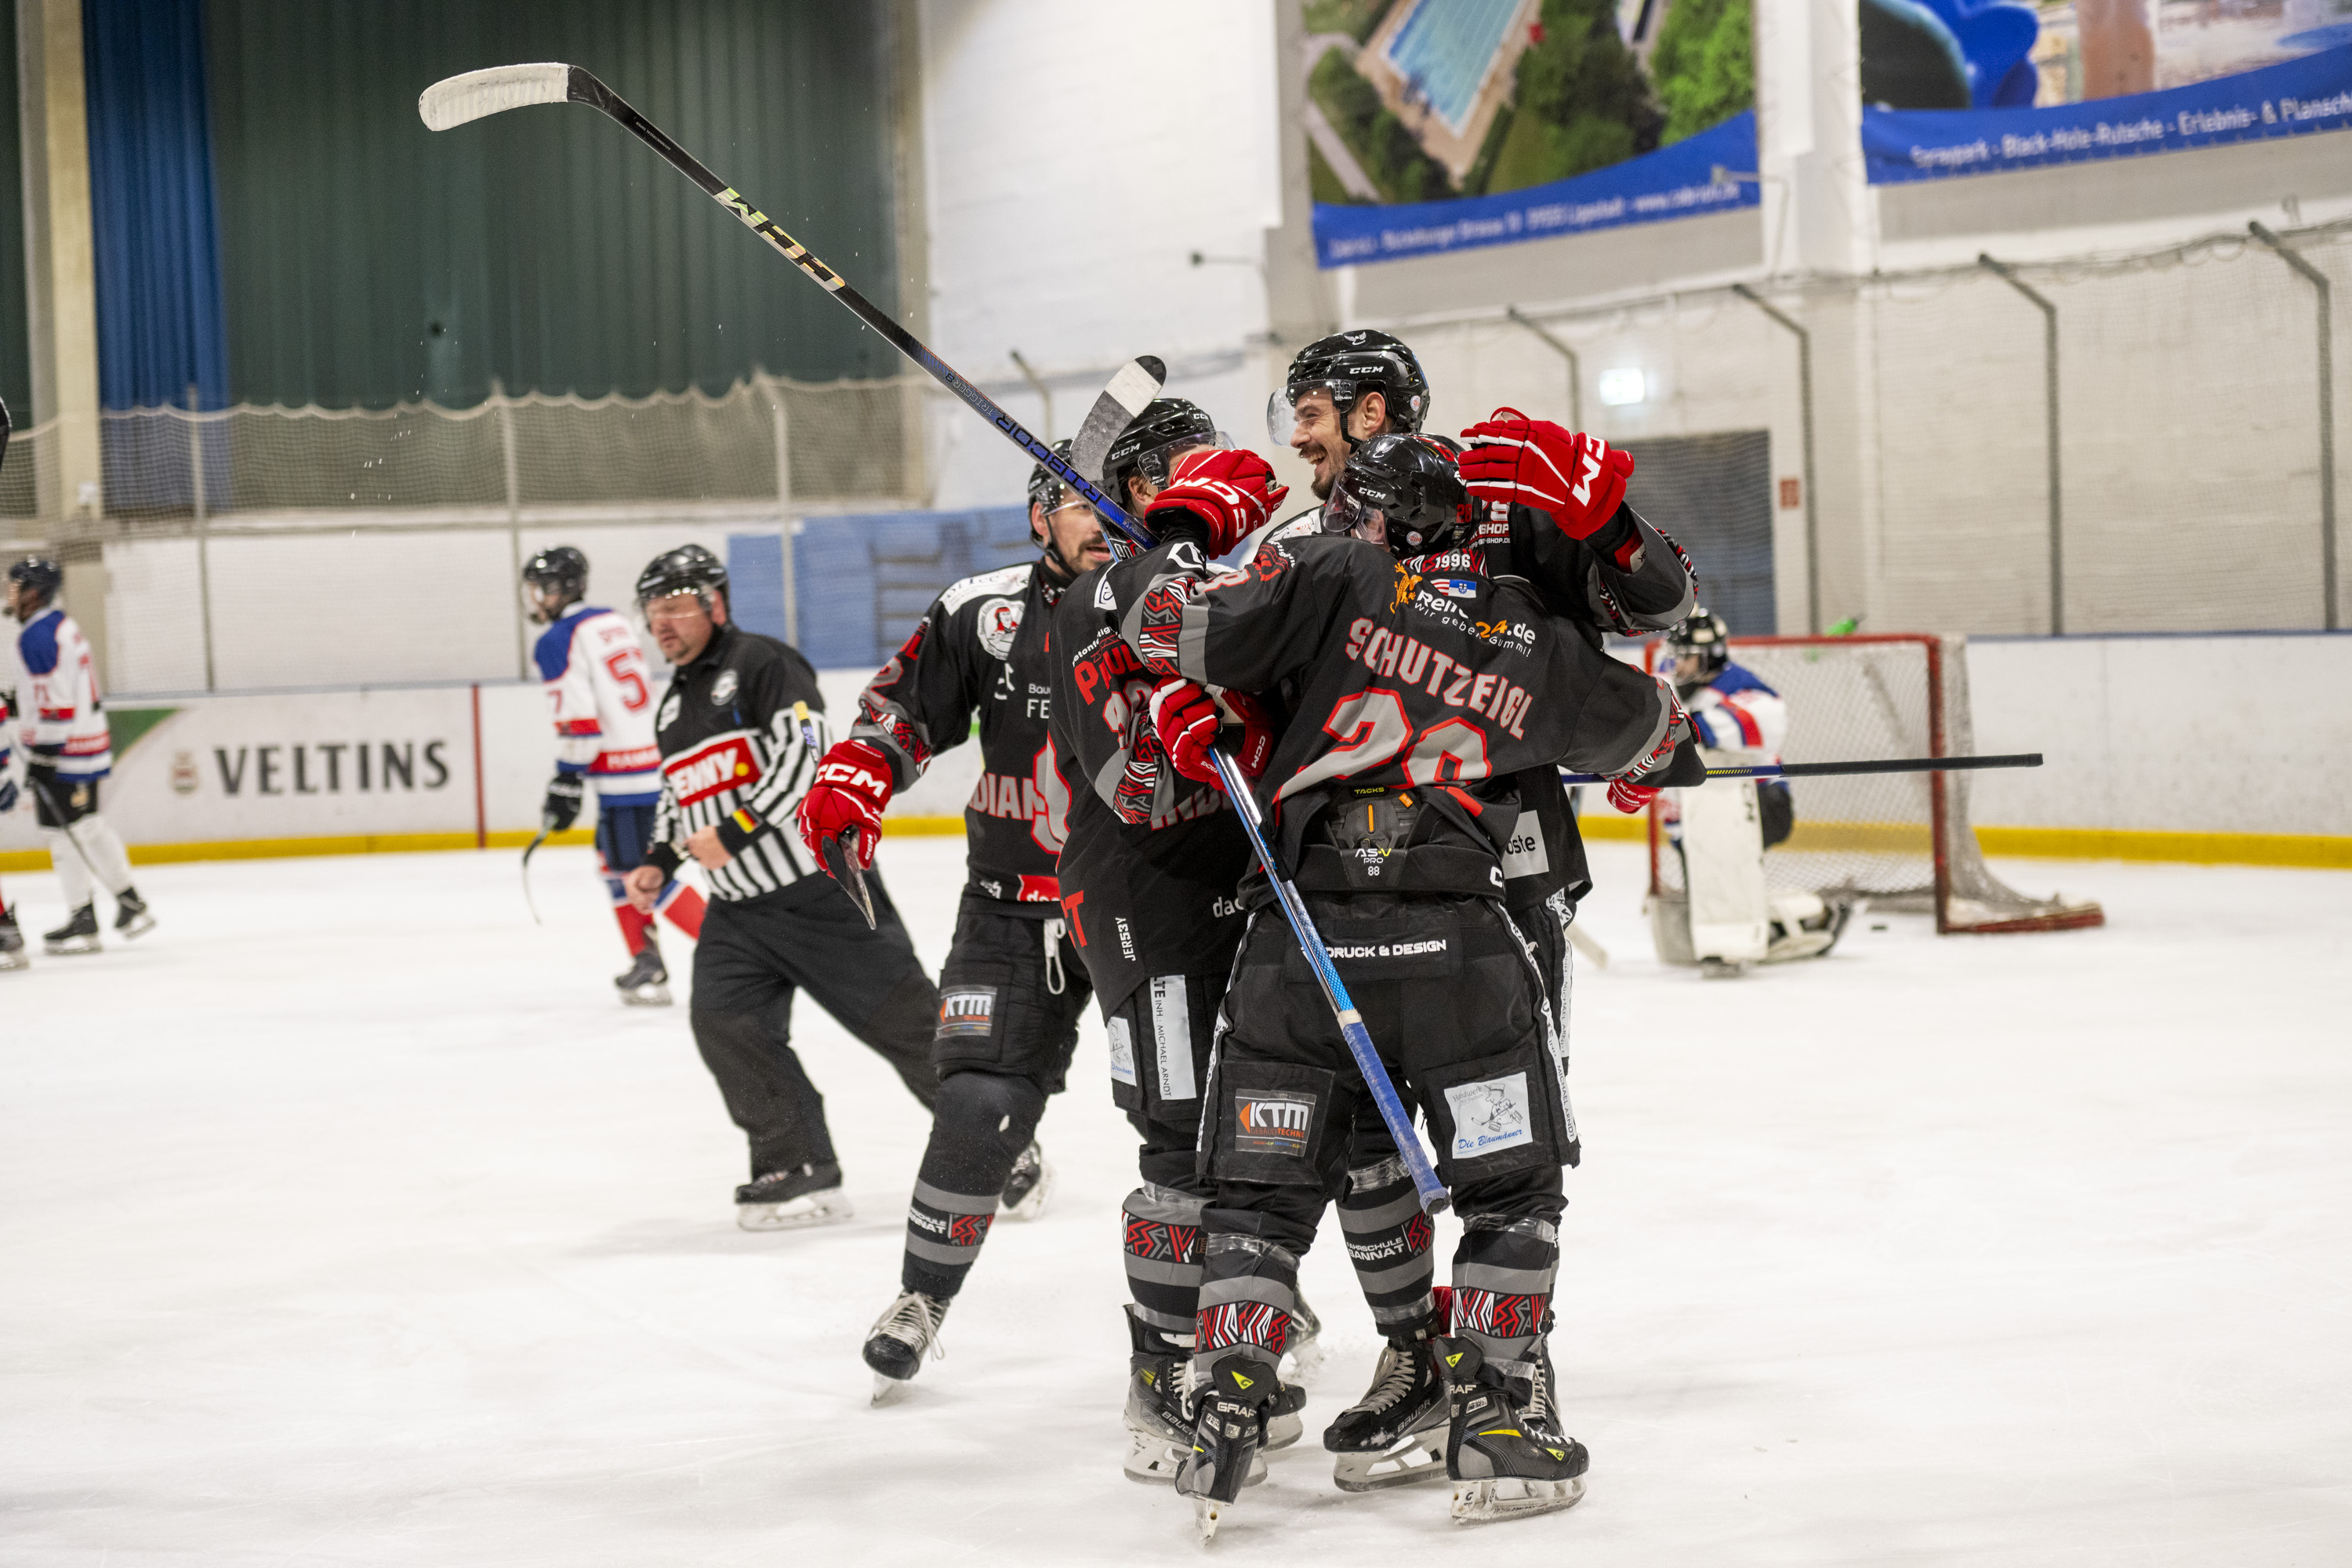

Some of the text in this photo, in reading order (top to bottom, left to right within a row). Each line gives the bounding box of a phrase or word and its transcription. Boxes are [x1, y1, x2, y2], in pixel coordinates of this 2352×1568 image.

[2261, 99, 2278, 125] &
[1348, 365, 1385, 376] CCM
[952, 378, 995, 417] TRIGGER
[995, 414, 1104, 505] RIBCOR
[1111, 443, 1141, 461] CCM
[1571, 433, 1606, 507] CM
[1357, 486, 1387, 500] CCM
[1456, 504, 1472, 524] 28
[1435, 554, 1471, 569] 1996
[1489, 636, 1532, 658] Gummi!
[1345, 617, 1534, 742] SCHUTZEIGL
[1250, 735, 1267, 769] CCM
[213, 739, 450, 797] VELTINS
[814, 762, 887, 799] CCM
[1353, 786, 1385, 795] TACKS
[1354, 848, 1392, 858] AS-V
[1367, 866, 1381, 877] 88
[1378, 945, 1390, 956] &
[1392, 939, 1447, 956] DESIGN
[945, 995, 993, 1018] KTM
[1156, 1025, 1168, 1065] MICHAEL
[1160, 1067, 1172, 1098] ARNDT
[1452, 1085, 1483, 1102] Handwerk
[1556, 1065, 1568, 1105] MICHAEL
[1564, 1108, 1575, 1138] ARNDT
[1250, 1102, 1309, 1131] KTM
[1457, 1129, 1524, 1150] Die Blaumänner
[1346, 1236, 1403, 1252] FAHRSCHULE
[1348, 1243, 1405, 1261] BANNAT
[1450, 1385, 1477, 1395] RAF
[1217, 1401, 1258, 1418] GRAF
